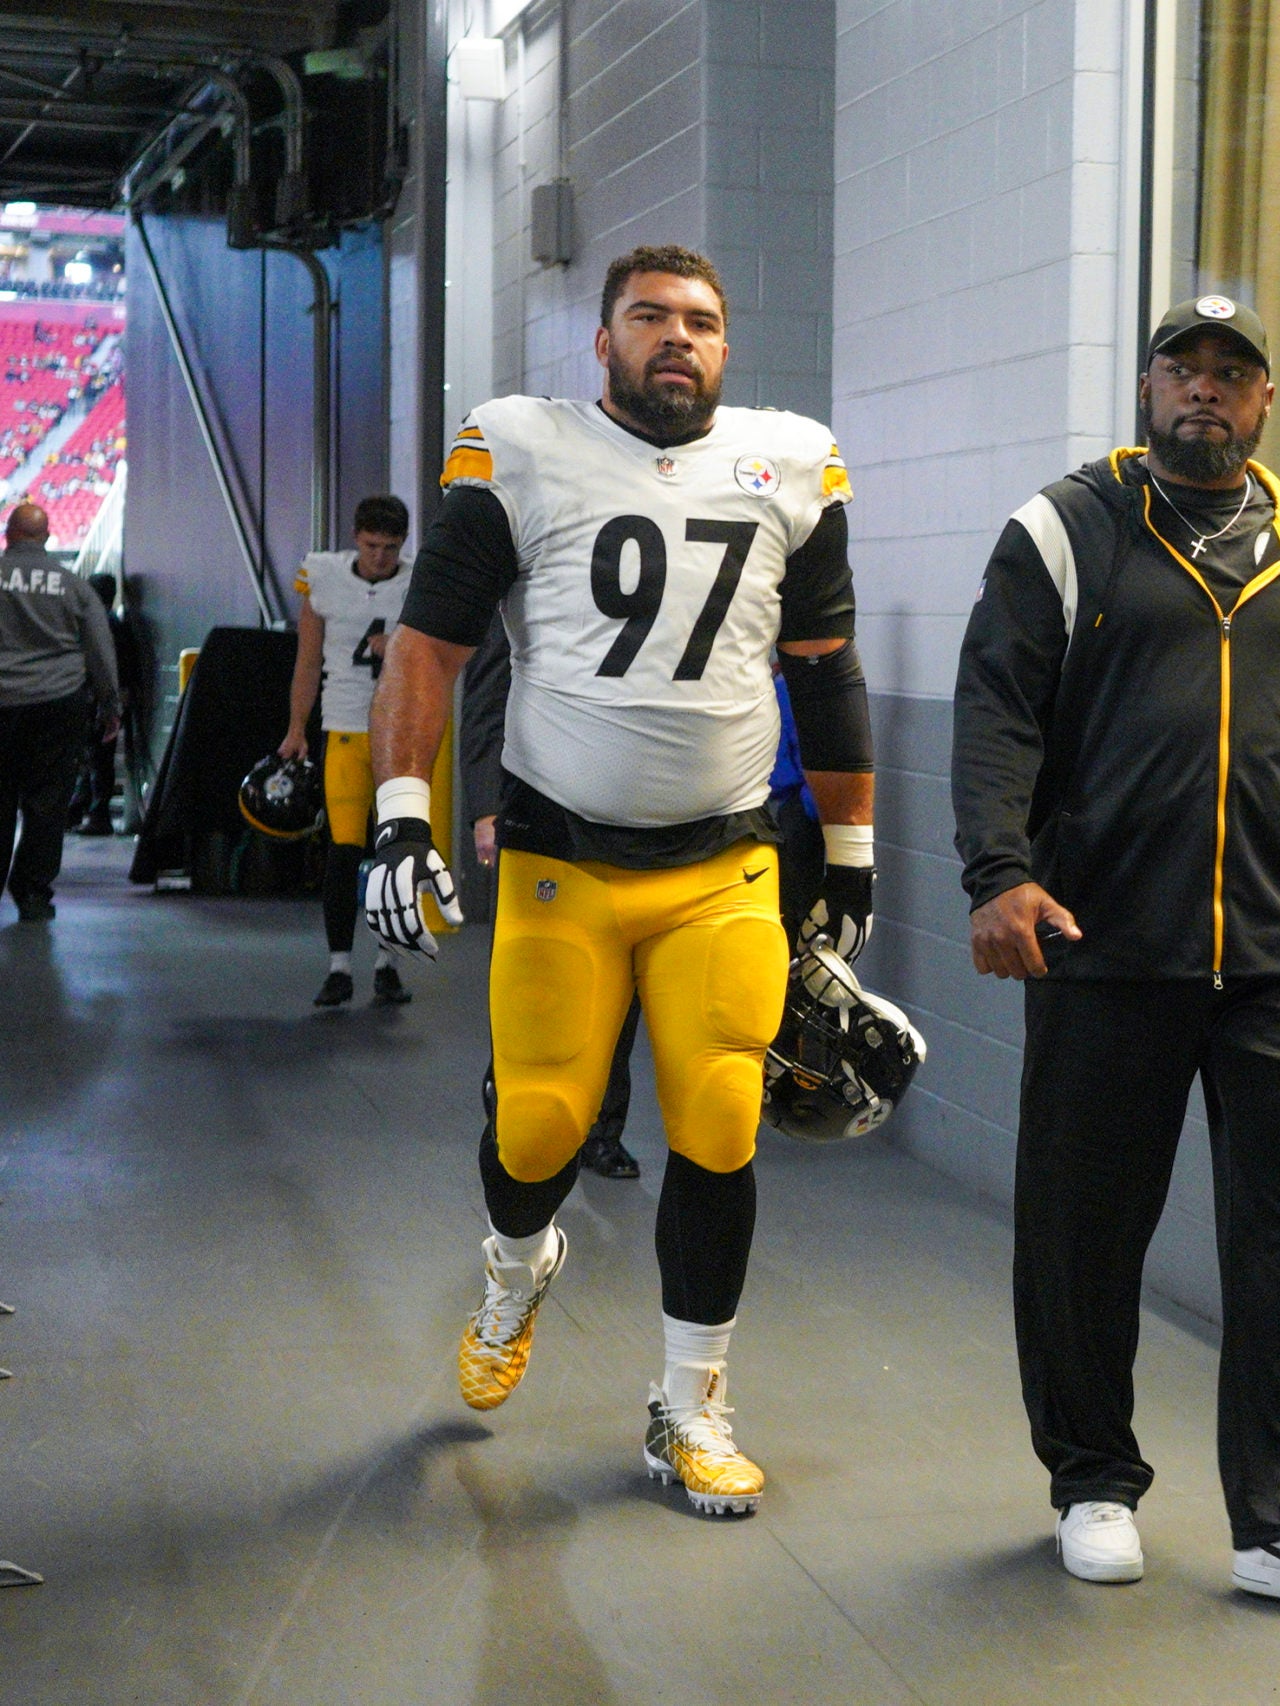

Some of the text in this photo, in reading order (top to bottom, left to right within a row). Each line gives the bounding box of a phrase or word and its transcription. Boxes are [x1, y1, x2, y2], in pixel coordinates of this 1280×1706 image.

[0, 567, 66, 596] .A.F.E.
[590, 514, 760, 681] 97
[352, 617, 387, 679] 4
